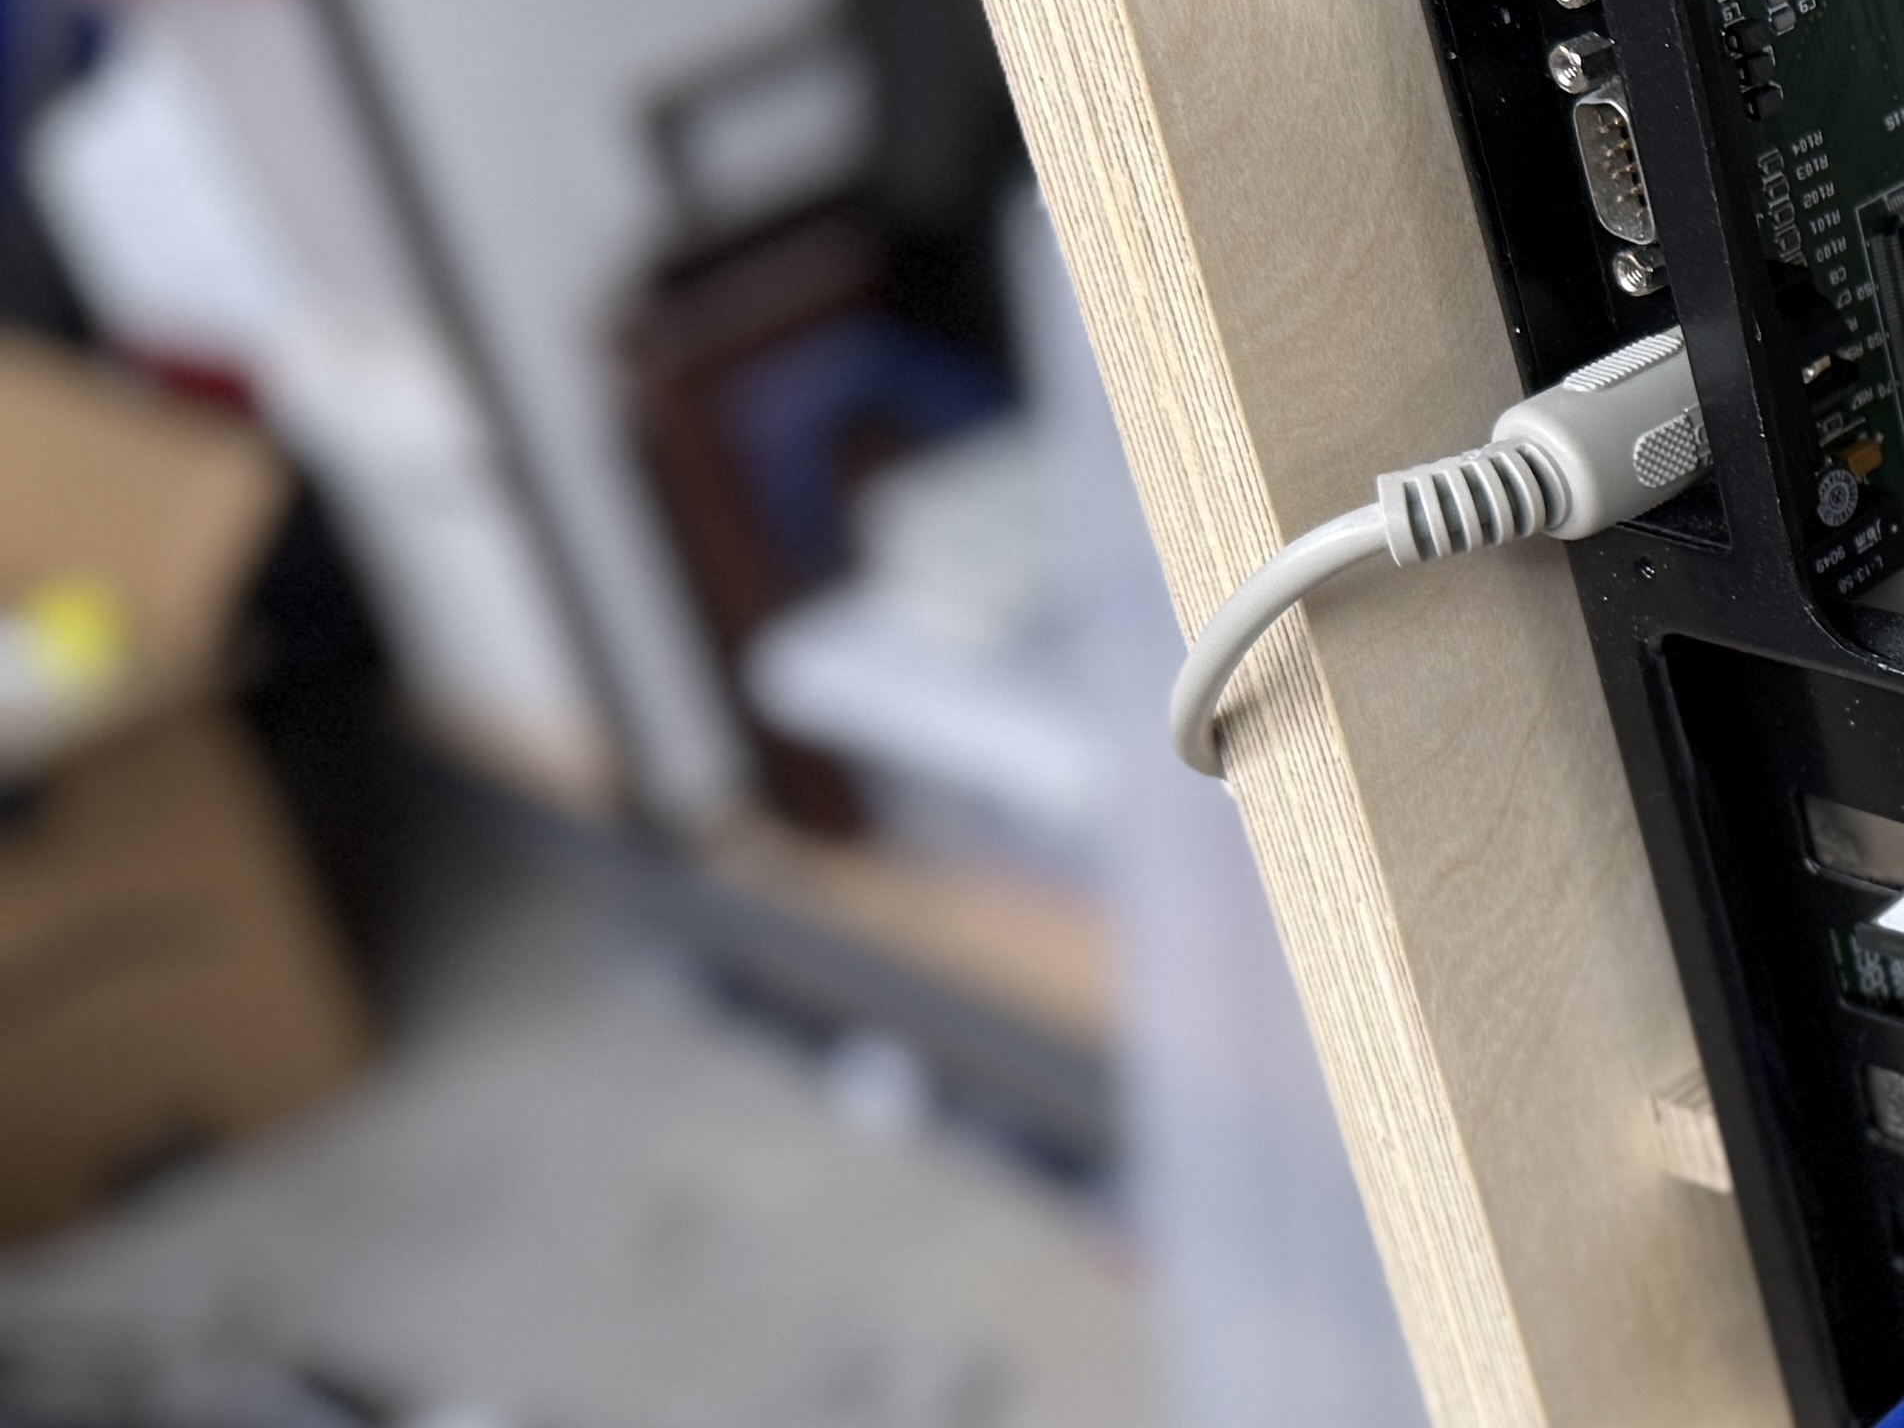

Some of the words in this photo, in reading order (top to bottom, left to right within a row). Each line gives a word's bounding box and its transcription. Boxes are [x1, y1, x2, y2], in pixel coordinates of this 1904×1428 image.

[1791, 129, 1824, 154] R104
[1795, 154, 1830, 181] R103
[1802, 182, 1836, 208] R102
[1808, 209, 1842, 235] R101
[1814, 236, 1848, 262] R100
